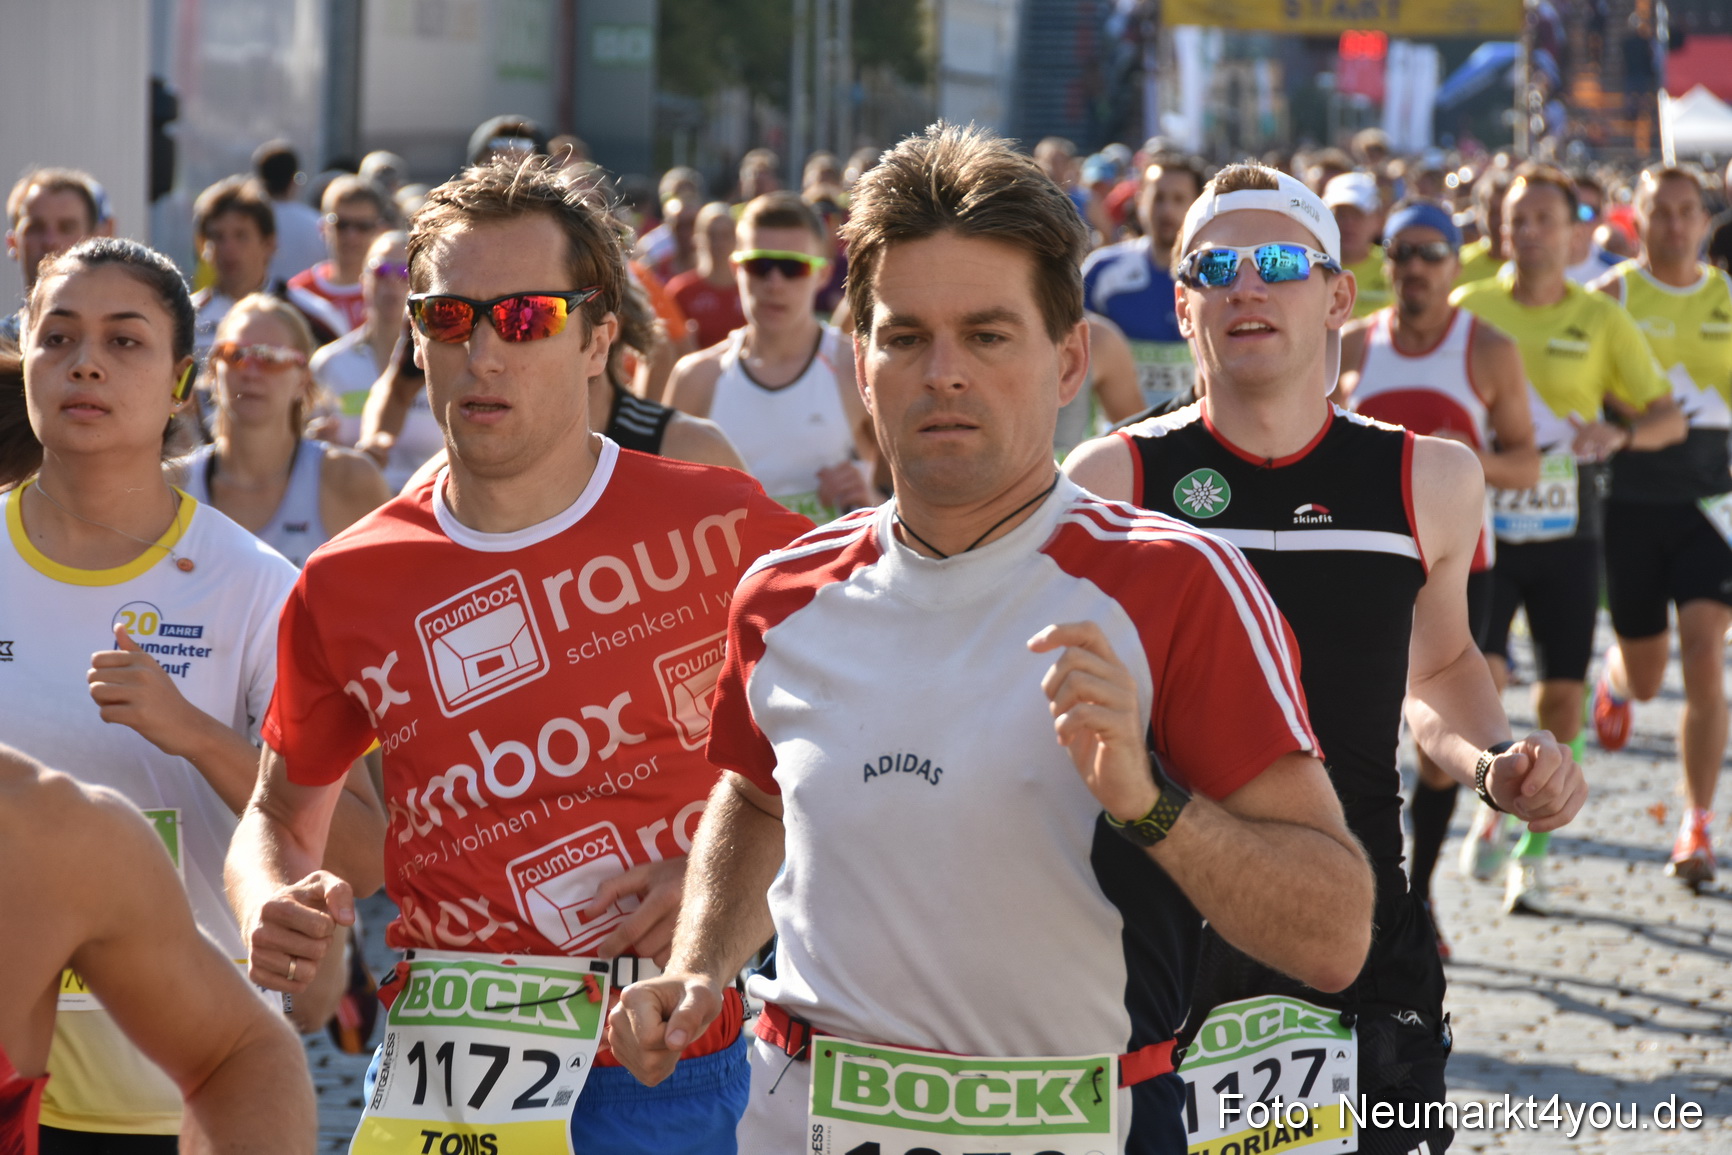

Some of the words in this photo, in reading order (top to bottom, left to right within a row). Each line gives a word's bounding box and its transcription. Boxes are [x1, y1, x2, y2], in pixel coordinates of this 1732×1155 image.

[1293, 514, 1333, 524] skinfit
[121, 611, 159, 636] 20
[161, 625, 201, 637] JAHRE
[424, 583, 518, 639] raumbox
[566, 605, 695, 665] schenken
[665, 639, 729, 683] raumb
[556, 755, 660, 811] outdoor
[863, 753, 944, 785] ADIDAS
[517, 835, 614, 888] raumbox
[398, 967, 582, 1031] BOCK
[407, 1040, 562, 1111] 1172
[831, 1051, 1090, 1126] BOCK
[420, 1130, 498, 1155] TOMS
